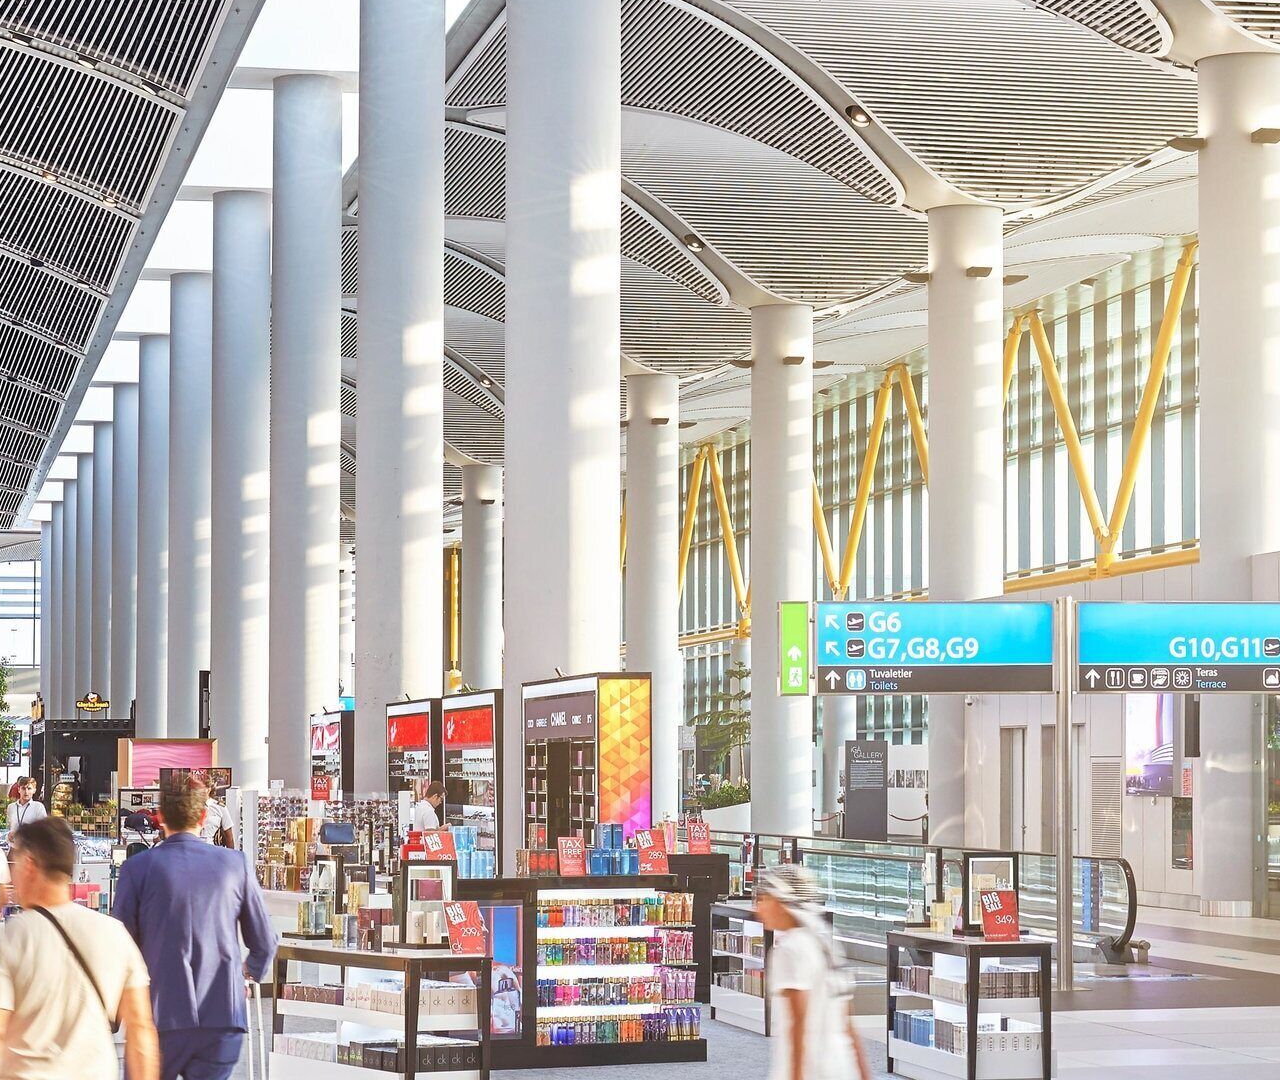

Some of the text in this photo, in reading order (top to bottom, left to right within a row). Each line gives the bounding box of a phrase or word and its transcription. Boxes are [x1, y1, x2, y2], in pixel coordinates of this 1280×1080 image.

[868, 611, 902, 633] G6
[867, 638, 979, 663] G7,G8,G9
[1169, 637, 1261, 661] G10,G11
[869, 669, 913, 679] Tuvaletler
[1196, 668, 1218, 677] Teras
[870, 680, 898, 690] Toilets
[1196, 680, 1227, 689] Terrace
[690, 824, 708, 832] TAX
[560, 839, 582, 848] TAX
[981, 892, 1000, 905] BIG
[445, 903, 463, 918] BIG
[985, 900, 1004, 913] SALE
[452, 938, 464, 951] ck
[422, 1054, 432, 1066] ck
[437, 1053, 447, 1065] ck
[451, 1052, 461, 1064] ck
[466, 1052, 476, 1064] ck
